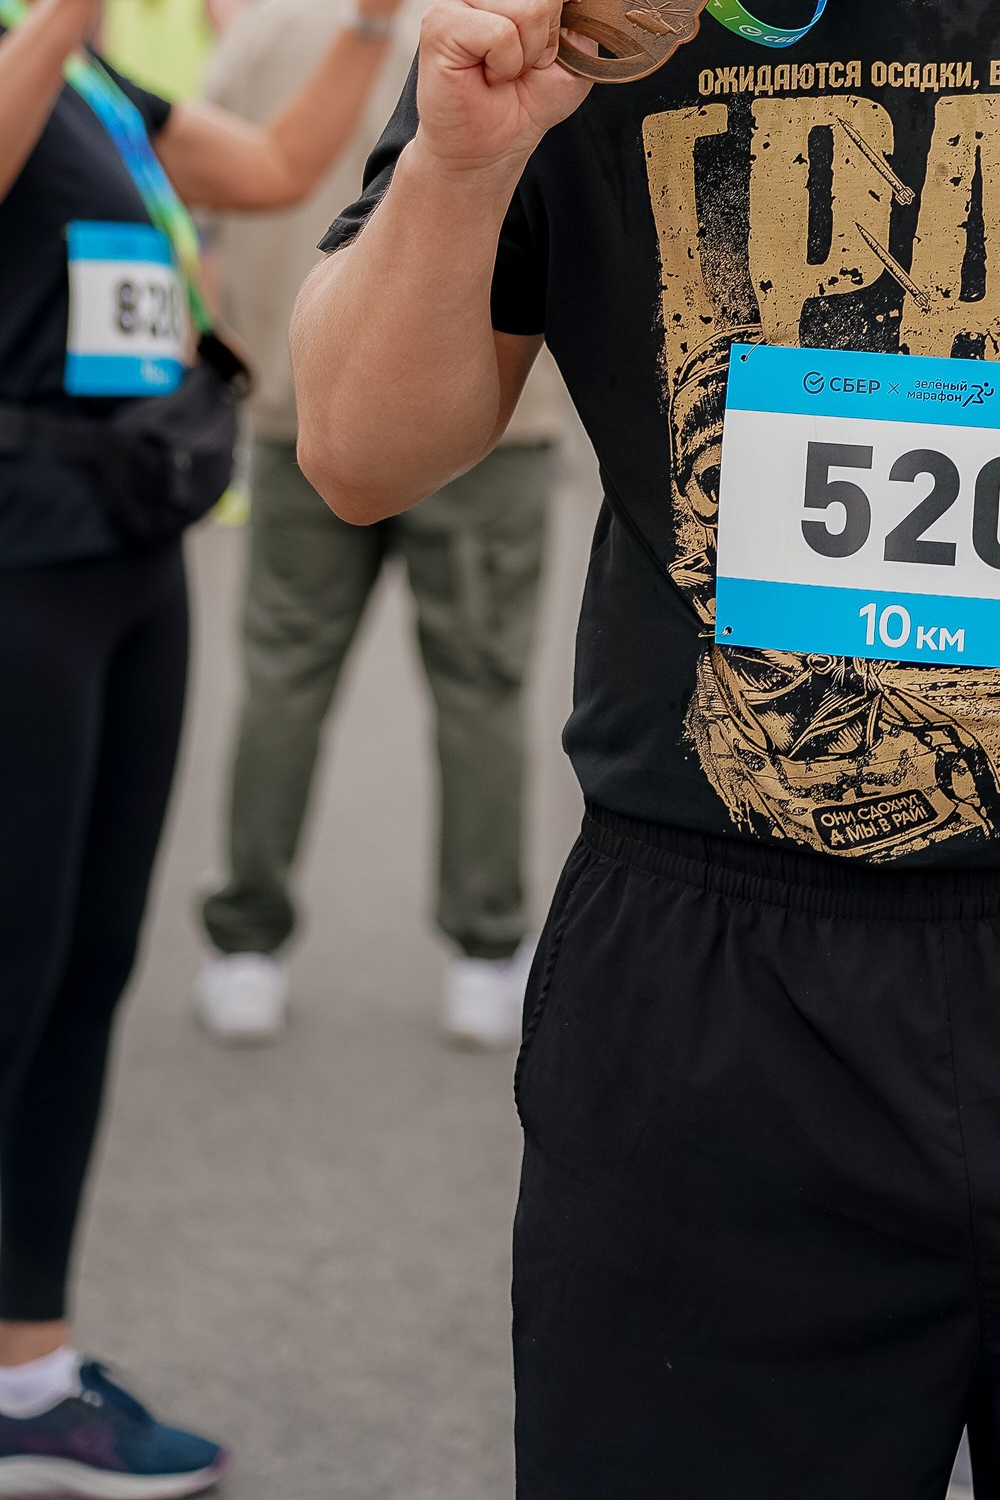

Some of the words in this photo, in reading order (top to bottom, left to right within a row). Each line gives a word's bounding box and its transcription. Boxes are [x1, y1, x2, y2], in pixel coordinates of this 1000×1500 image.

[698, 60, 862, 96] ОЖИДАЮТСЯ
[870, 60, 980, 93] ОСАДКИ,
[829, 376, 882, 395] СБЕР
[906, 389, 963, 403] марафон
[913, 377, 968, 392] зелёный
[858, 603, 911, 648] 10
[820, 808, 856, 827] ОНИ
[857, 794, 919, 820] СДОХНУТ
[829, 828, 846, 847] А
[845, 821, 880, 842] МЫ
[877, 817, 892, 833] В
[891, 805, 929, 828] РАЙ!
